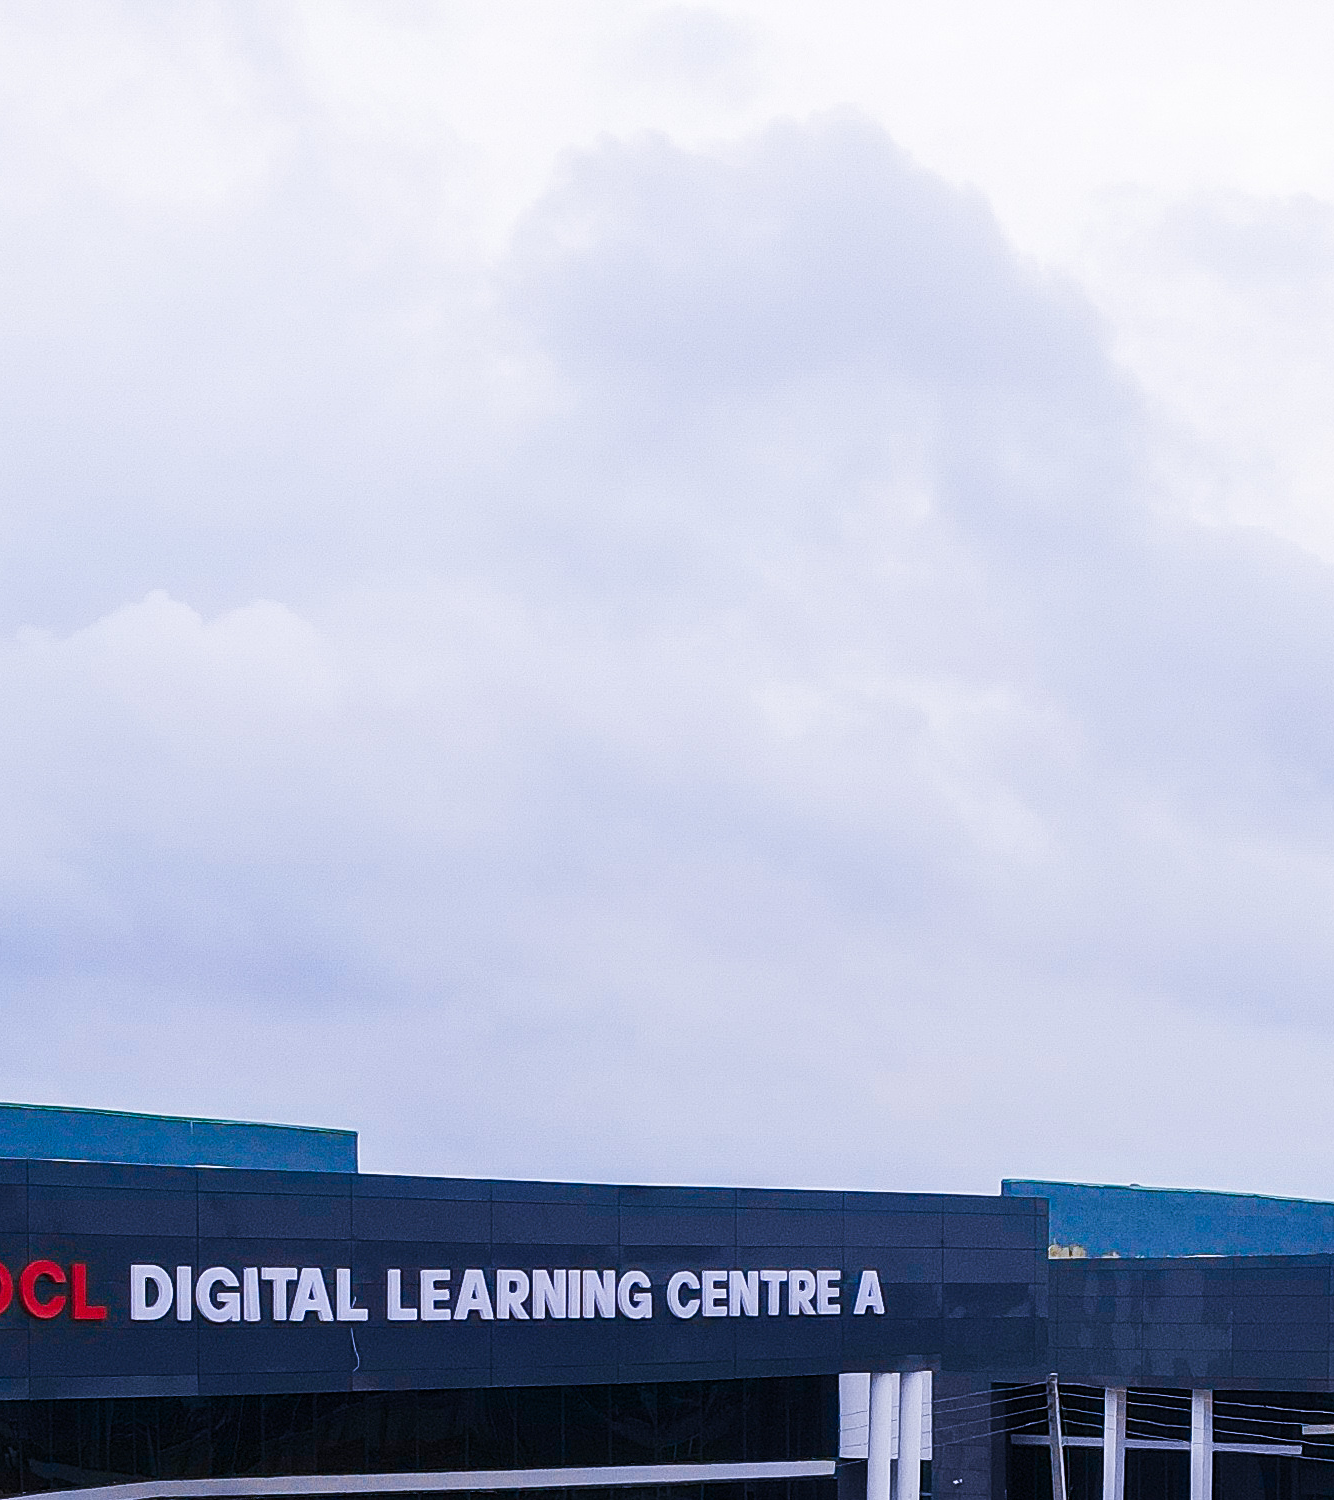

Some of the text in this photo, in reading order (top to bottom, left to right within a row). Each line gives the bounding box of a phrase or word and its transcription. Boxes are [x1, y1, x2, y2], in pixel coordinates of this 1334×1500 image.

[130, 1264, 370, 1322] DIGITAL
[387, 1268, 653, 1320] LEARNING
[666, 1269, 841, 1319] CENTRE
[853, 1270, 887, 1315] A
